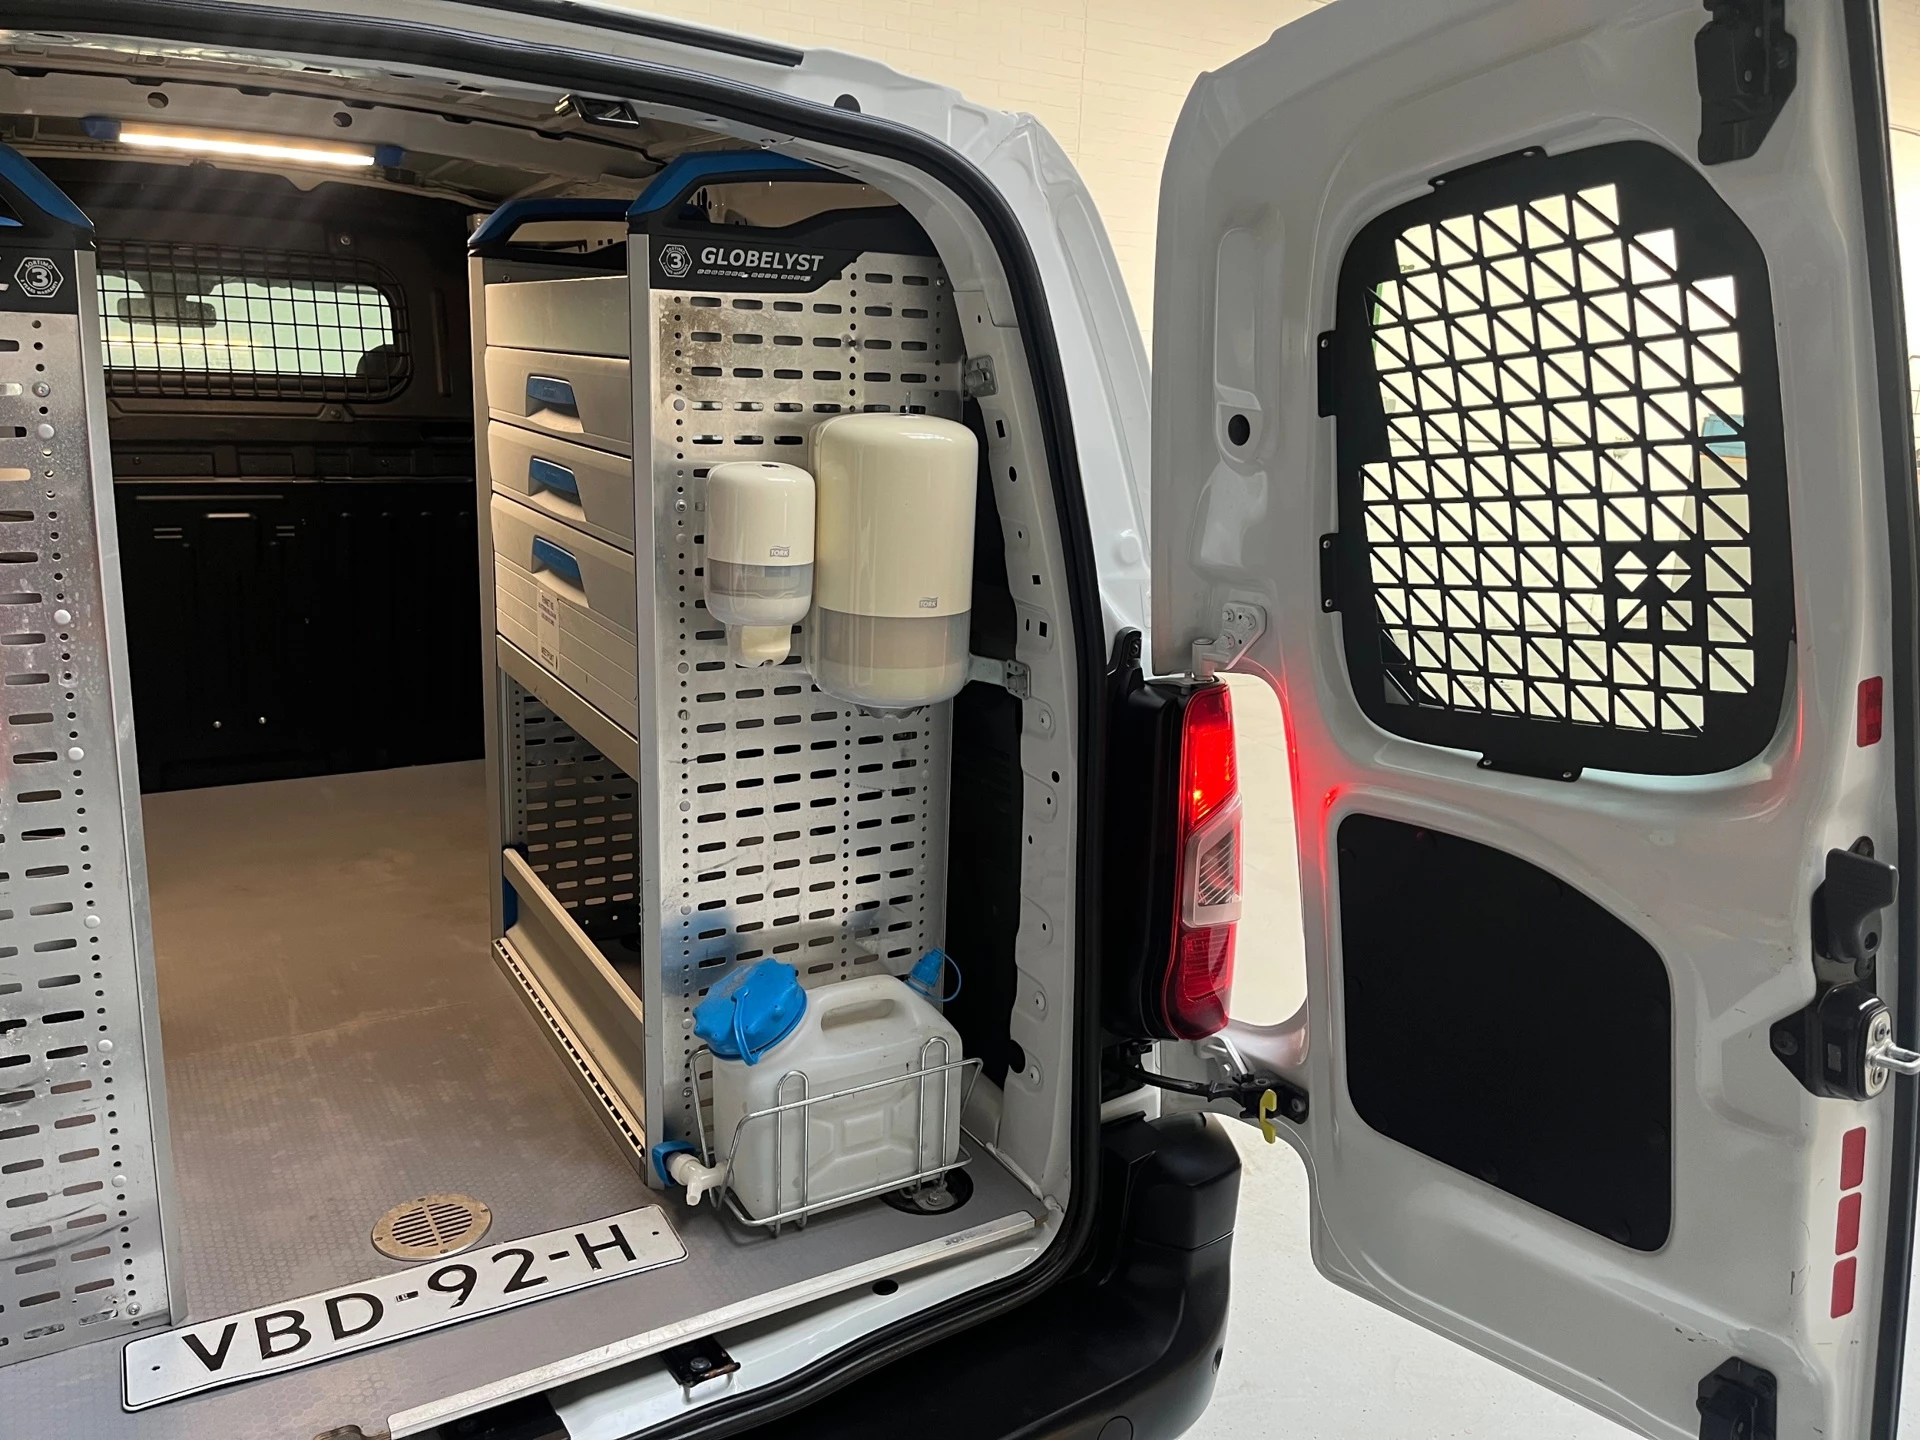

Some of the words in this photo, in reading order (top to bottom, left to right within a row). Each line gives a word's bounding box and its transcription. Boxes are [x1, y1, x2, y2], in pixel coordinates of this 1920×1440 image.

[25, 260, 53, 270] SORTIMO
[670, 253, 682, 269] 3
[701, 247, 824, 271] GLOBELYST
[32, 268, 49, 287] 3
[770, 548, 789, 557] TORK
[919, 599, 937, 608] TORK
[181, 1223, 638, 1372] VBD-92-H
